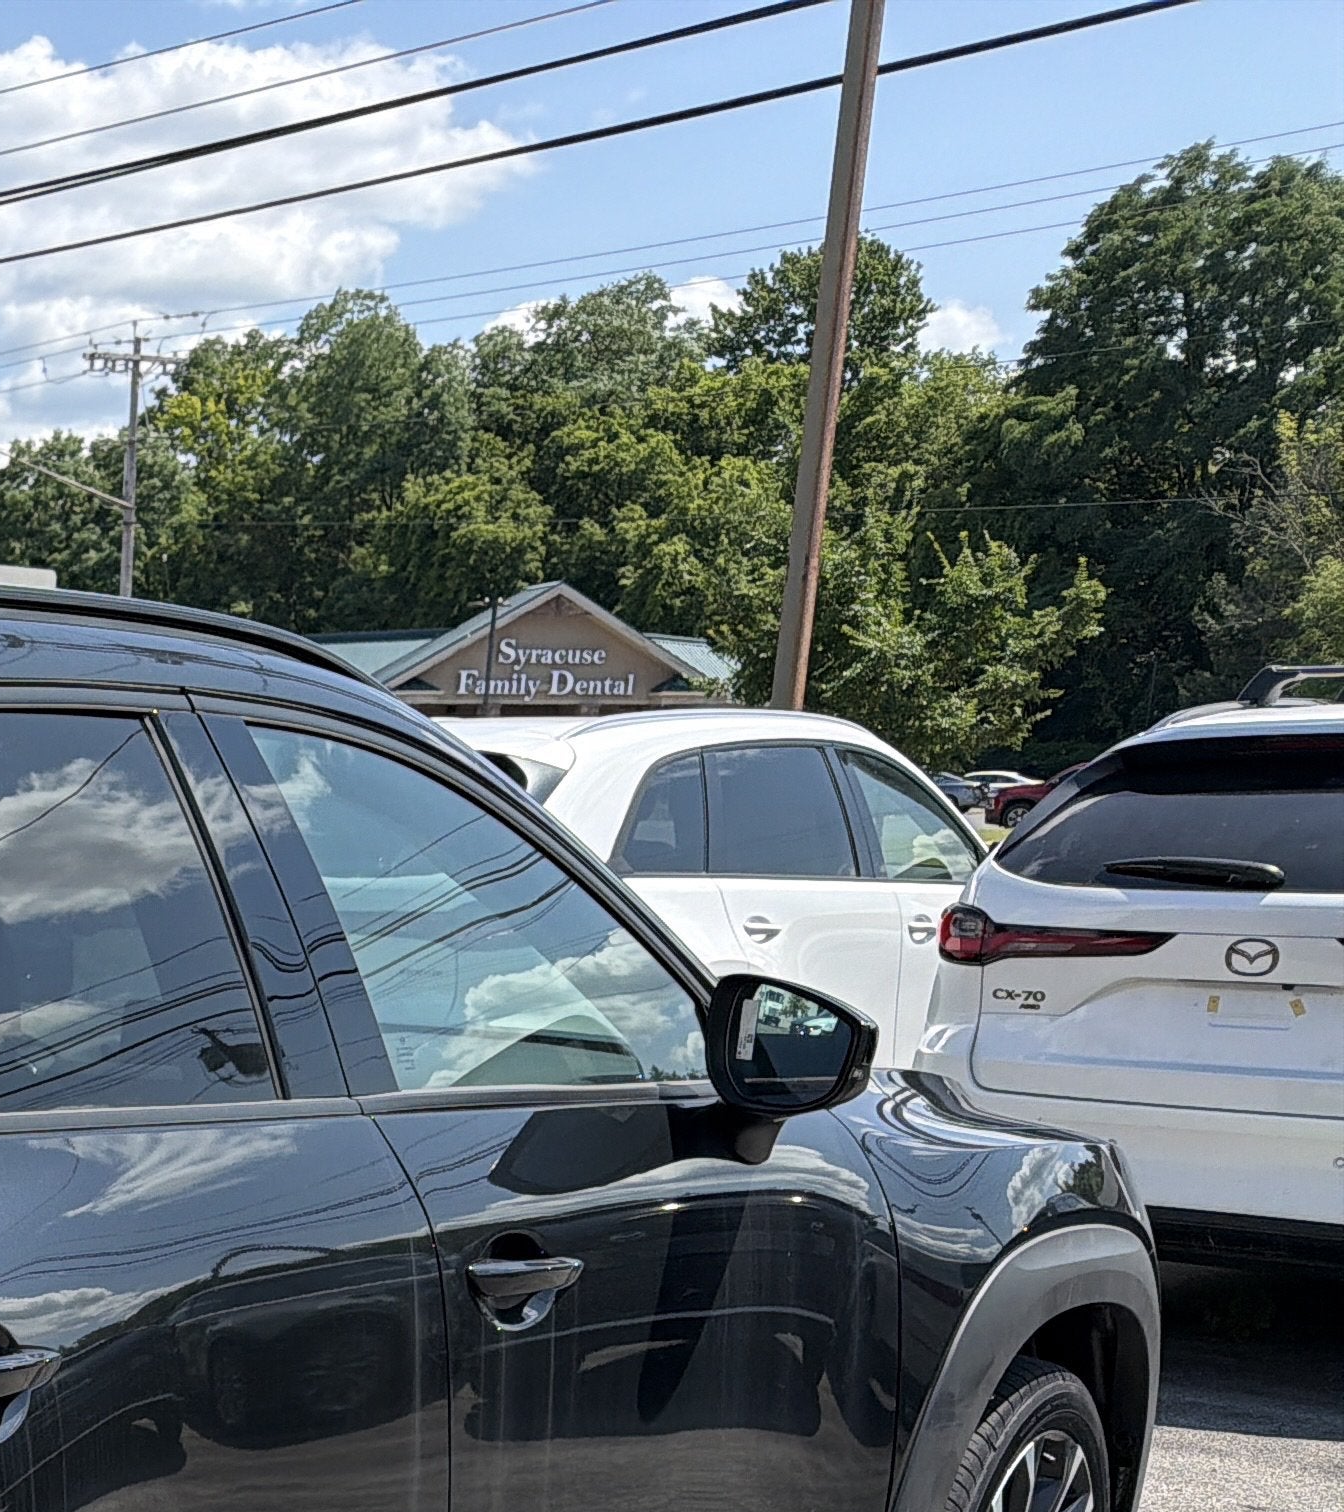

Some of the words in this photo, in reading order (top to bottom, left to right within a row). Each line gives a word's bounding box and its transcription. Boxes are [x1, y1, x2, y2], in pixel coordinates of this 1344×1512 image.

[498, 638, 607, 671] Syracuse
[456, 669, 541, 702] Family
[547, 669, 636, 696] Dental
[992, 988, 1047, 1002] CX-70
